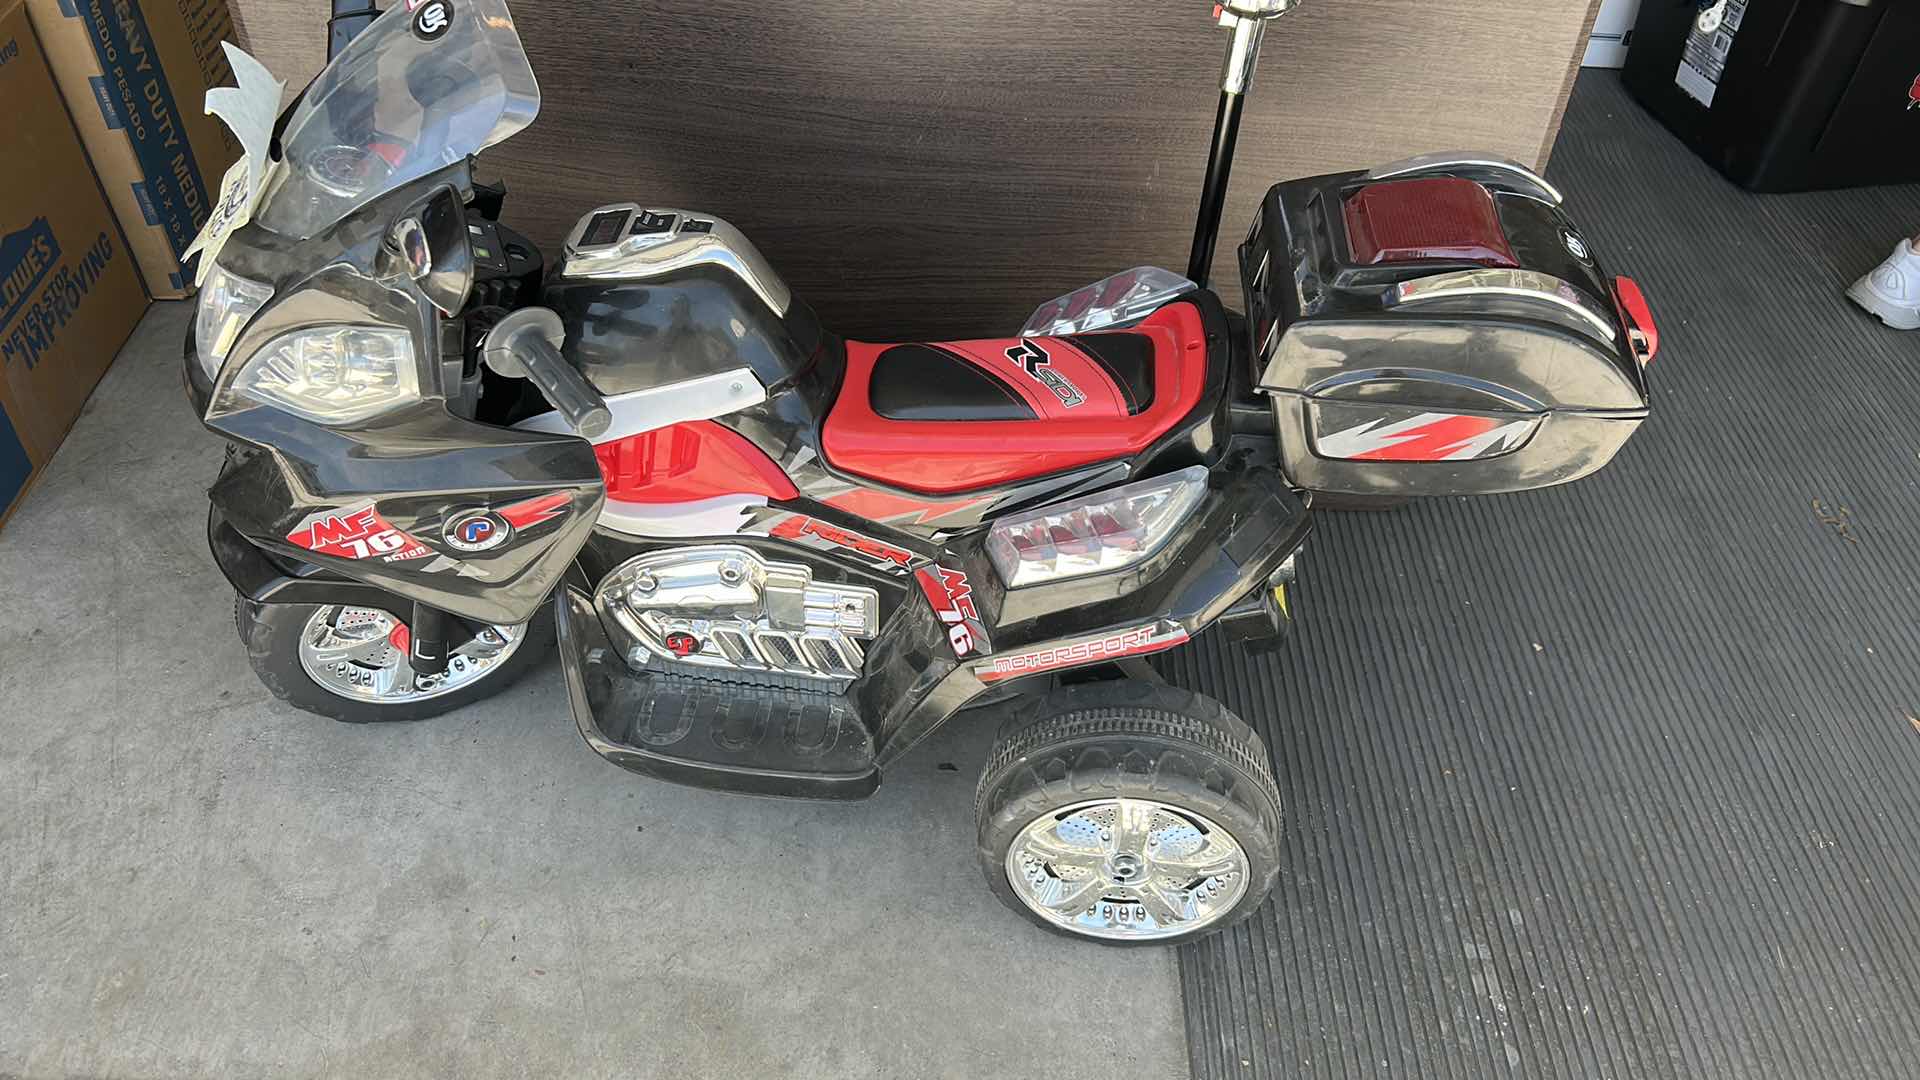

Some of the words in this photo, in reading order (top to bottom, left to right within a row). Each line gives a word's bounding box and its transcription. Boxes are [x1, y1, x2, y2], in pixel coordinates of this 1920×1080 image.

[113, 66, 146, 141] PESADO
[143, 79, 180, 148] DUTY
[19, 231, 113, 371] IMPROVING
[2, 303, 47, 365] NEVER
[310, 503, 377, 550] MF
[935, 563, 979, 621] MF
[993, 625, 1157, 673] MOTORSPORT
